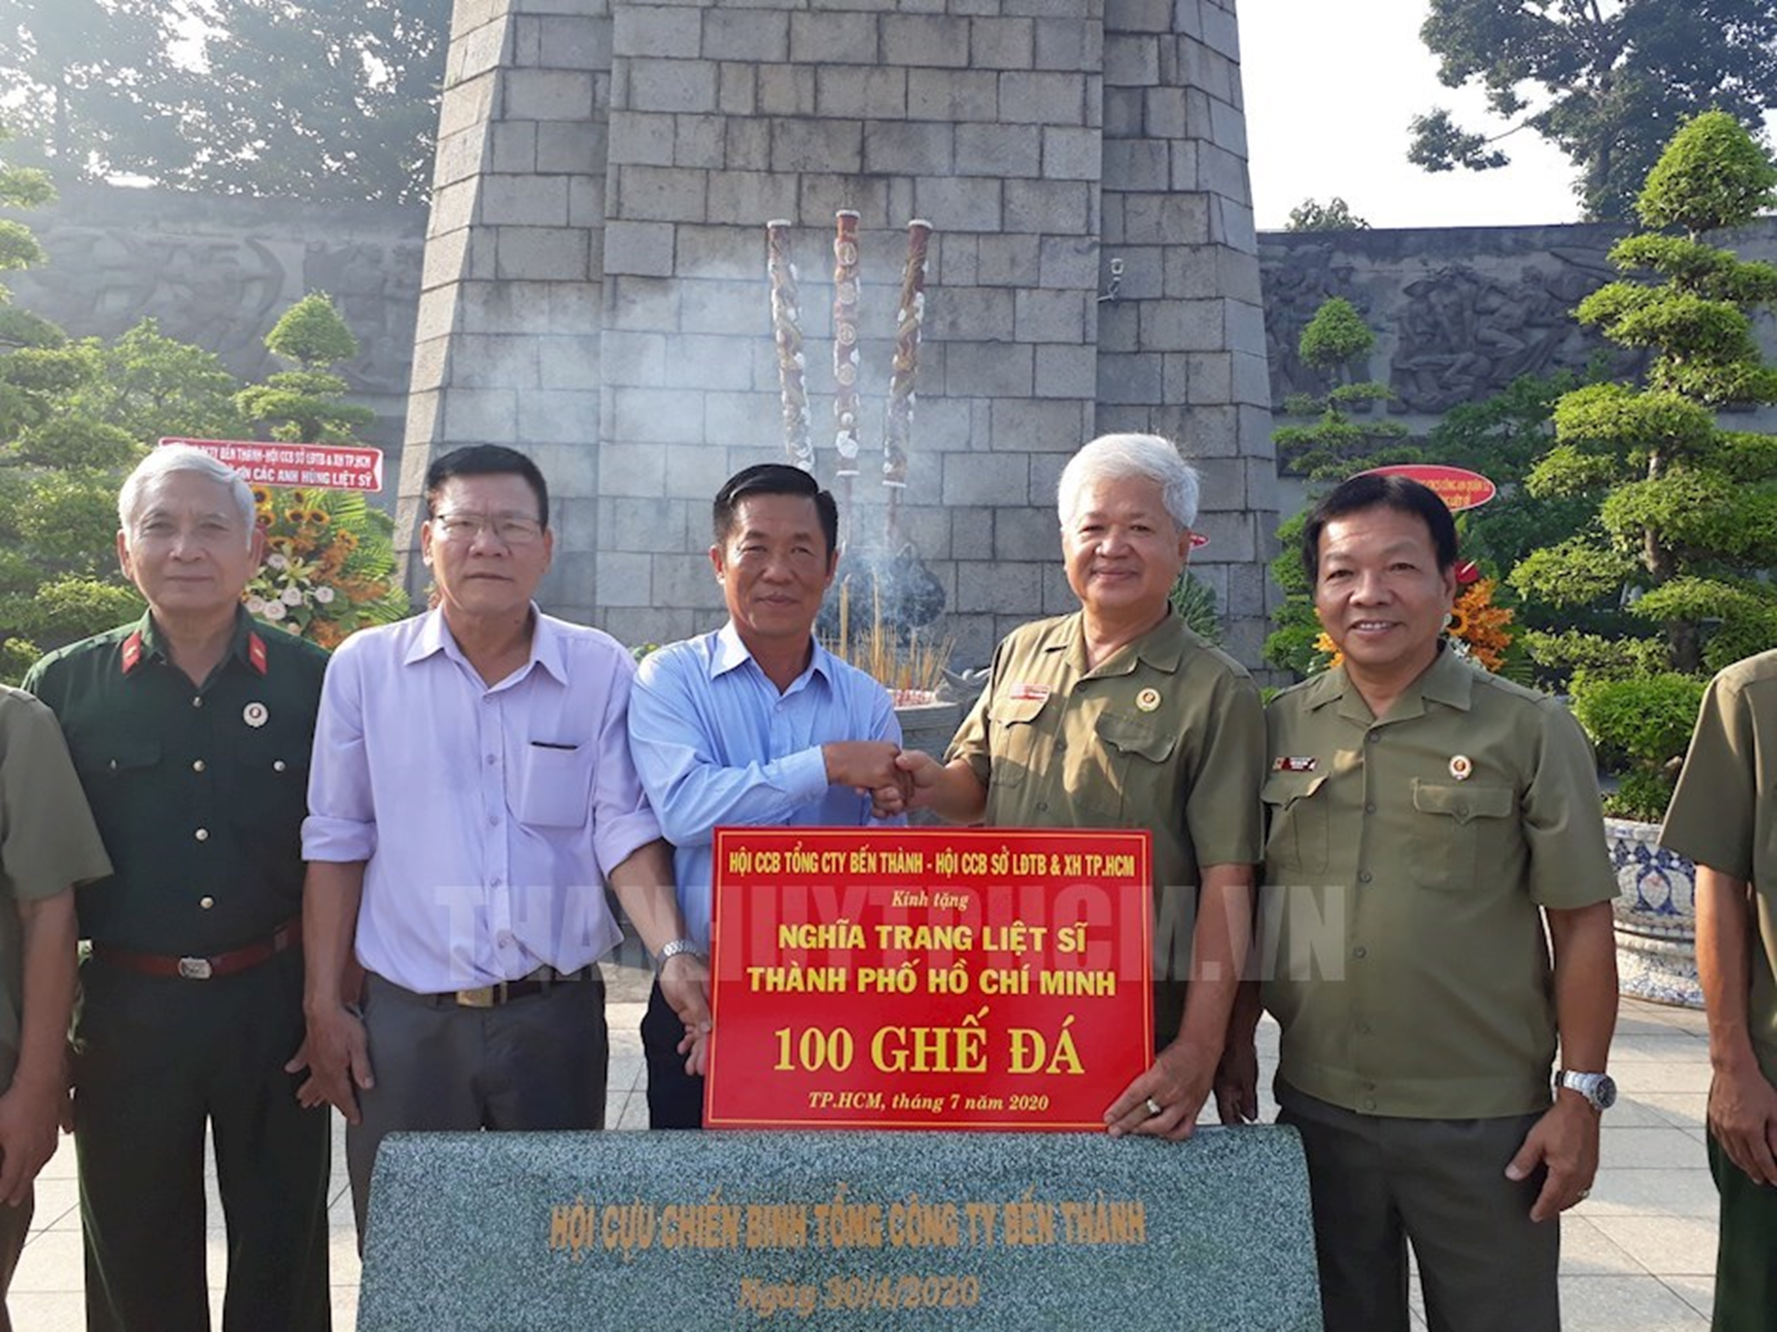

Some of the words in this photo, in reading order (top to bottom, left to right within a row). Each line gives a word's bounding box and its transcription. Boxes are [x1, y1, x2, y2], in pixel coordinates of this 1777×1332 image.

[253, 467, 275, 482] CÁC
[277, 469, 298, 483] ANH
[301, 469, 330, 484] HÙNG
[332, 470, 354, 487] LIỆT
[729, 846, 752, 880] HỘI
[754, 851, 780, 873] CCB
[784, 840, 818, 874] TỔNG
[821, 851, 845, 874] CTY
[850, 844, 877, 874] BẾN
[880, 846, 923, 874] THÀNH
[935, 847, 958, 879] HỘI
[961, 853, 987, 875] CCB
[991, 848, 1010, 876] SỞ
[1013, 853, 1047, 876] LĐTB
[1050, 854, 1061, 876] &
[1064, 854, 1082, 877] XH
[1085, 854, 1135, 878] TP.HCM
[891, 890, 928, 908] Kính
[933, 891, 969, 911] tặng
[778, 918, 867, 951] NGHĨA
[875, 924, 973, 952] TRANG
[982, 920, 1048, 956] LIỆT
[1057, 921, 1087, 953] SĨ
[746, 957, 846, 993] THÀNH
[857, 958, 920, 994] PHỐ
[928, 958, 969, 995] HỒ
[978, 960, 1030, 996] CHÍ
[1040, 970, 1116, 996] MINH
[773, 1026, 854, 1072] 100
[870, 1005, 991, 1073] GHẾ
[1007, 1015, 1086, 1075] ĐÁ
[808, 1091, 886, 1111] TP.HCM,
[891, 1093, 944, 1113] tháng
[950, 1094, 960, 1110] 7
[965, 1095, 1004, 1111] năm
[1009, 1094, 1050, 1112] 2020
[550, 1194, 595, 1263] HỘI
[661, 1184, 742, 1250] CHIẾN
[746, 1203, 807, 1249] BINH
[813, 1182, 883, 1249] TỔNG
[888, 1192, 959, 1249] CÔNG
[964, 1201, 1000, 1248] TY
[1003, 1184, 1055, 1246] BẾN
[1059, 1189, 1146, 1245] THÀNH
[824, 1274, 980, 1310] 30/4/2020
